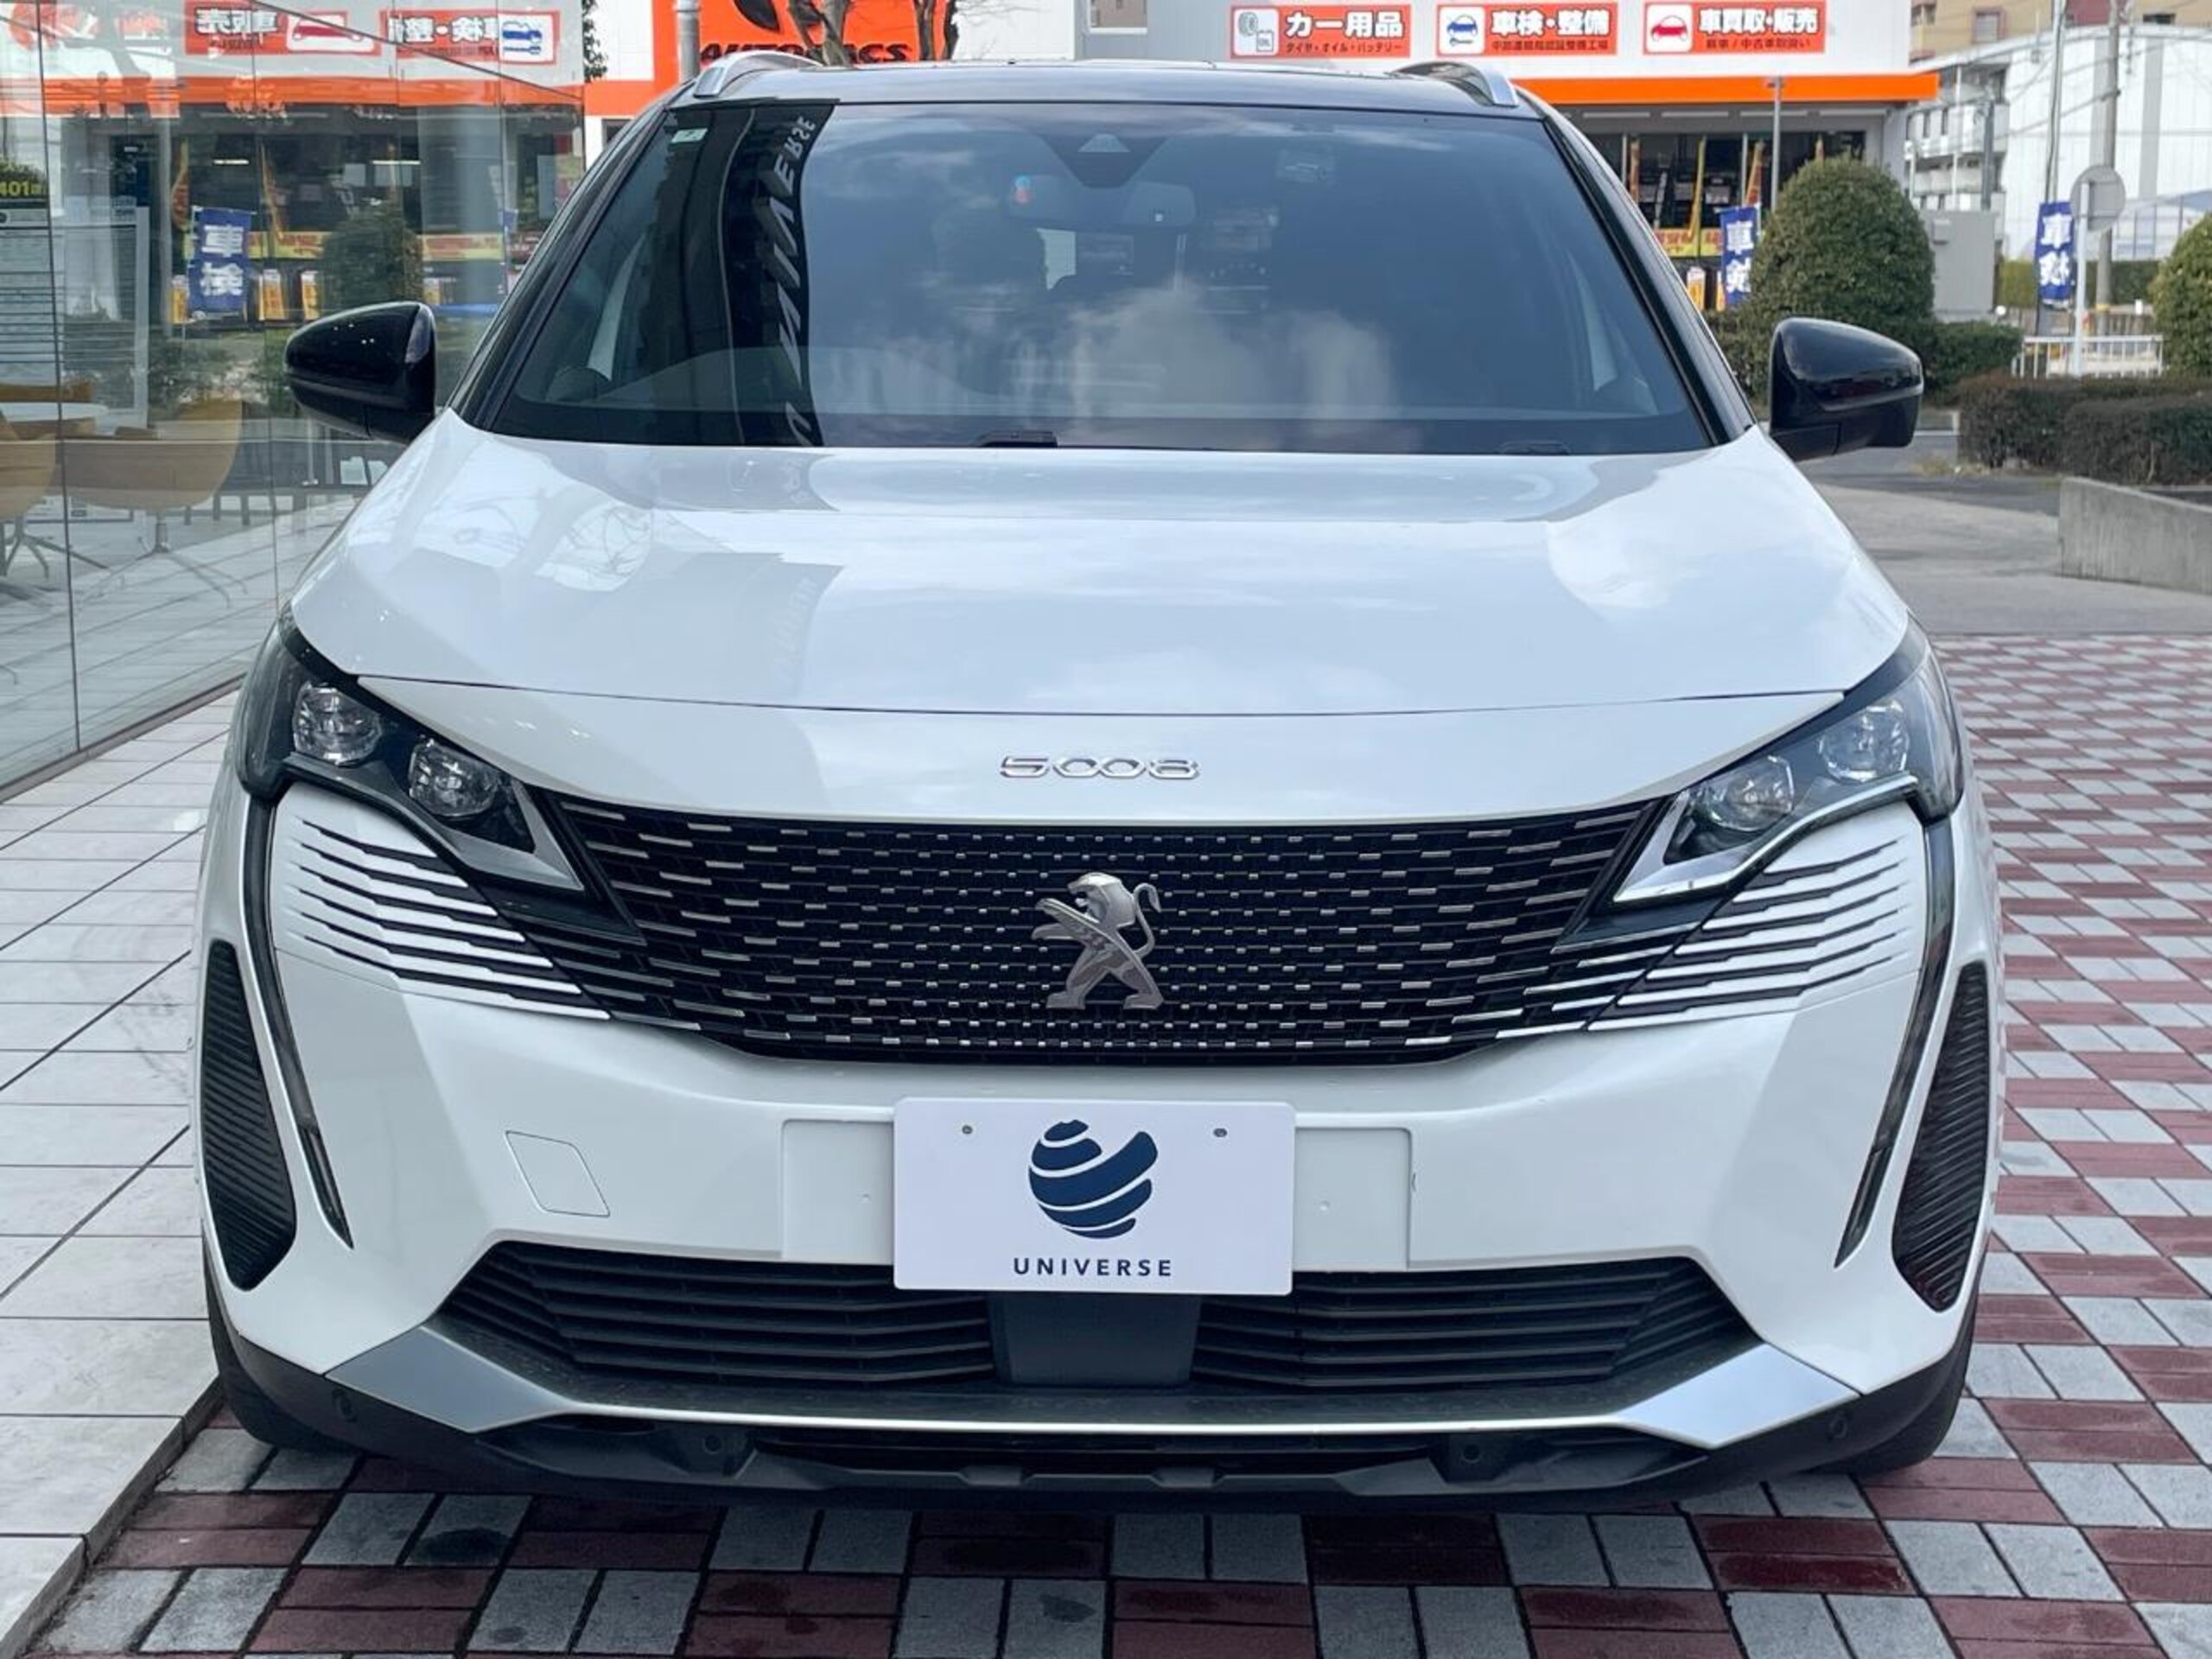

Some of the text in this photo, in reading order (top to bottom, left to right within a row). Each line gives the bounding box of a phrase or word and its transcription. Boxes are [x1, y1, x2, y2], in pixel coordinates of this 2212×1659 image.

[1285, 11, 1405, 38] カー用品
[1491, 9, 1611, 37] 車検・整備
[1698, 8, 1819, 35] 車買取・販売
[1000, 757, 1200, 779] 5008
[1014, 1257, 1172, 1276] UNIVERSE
